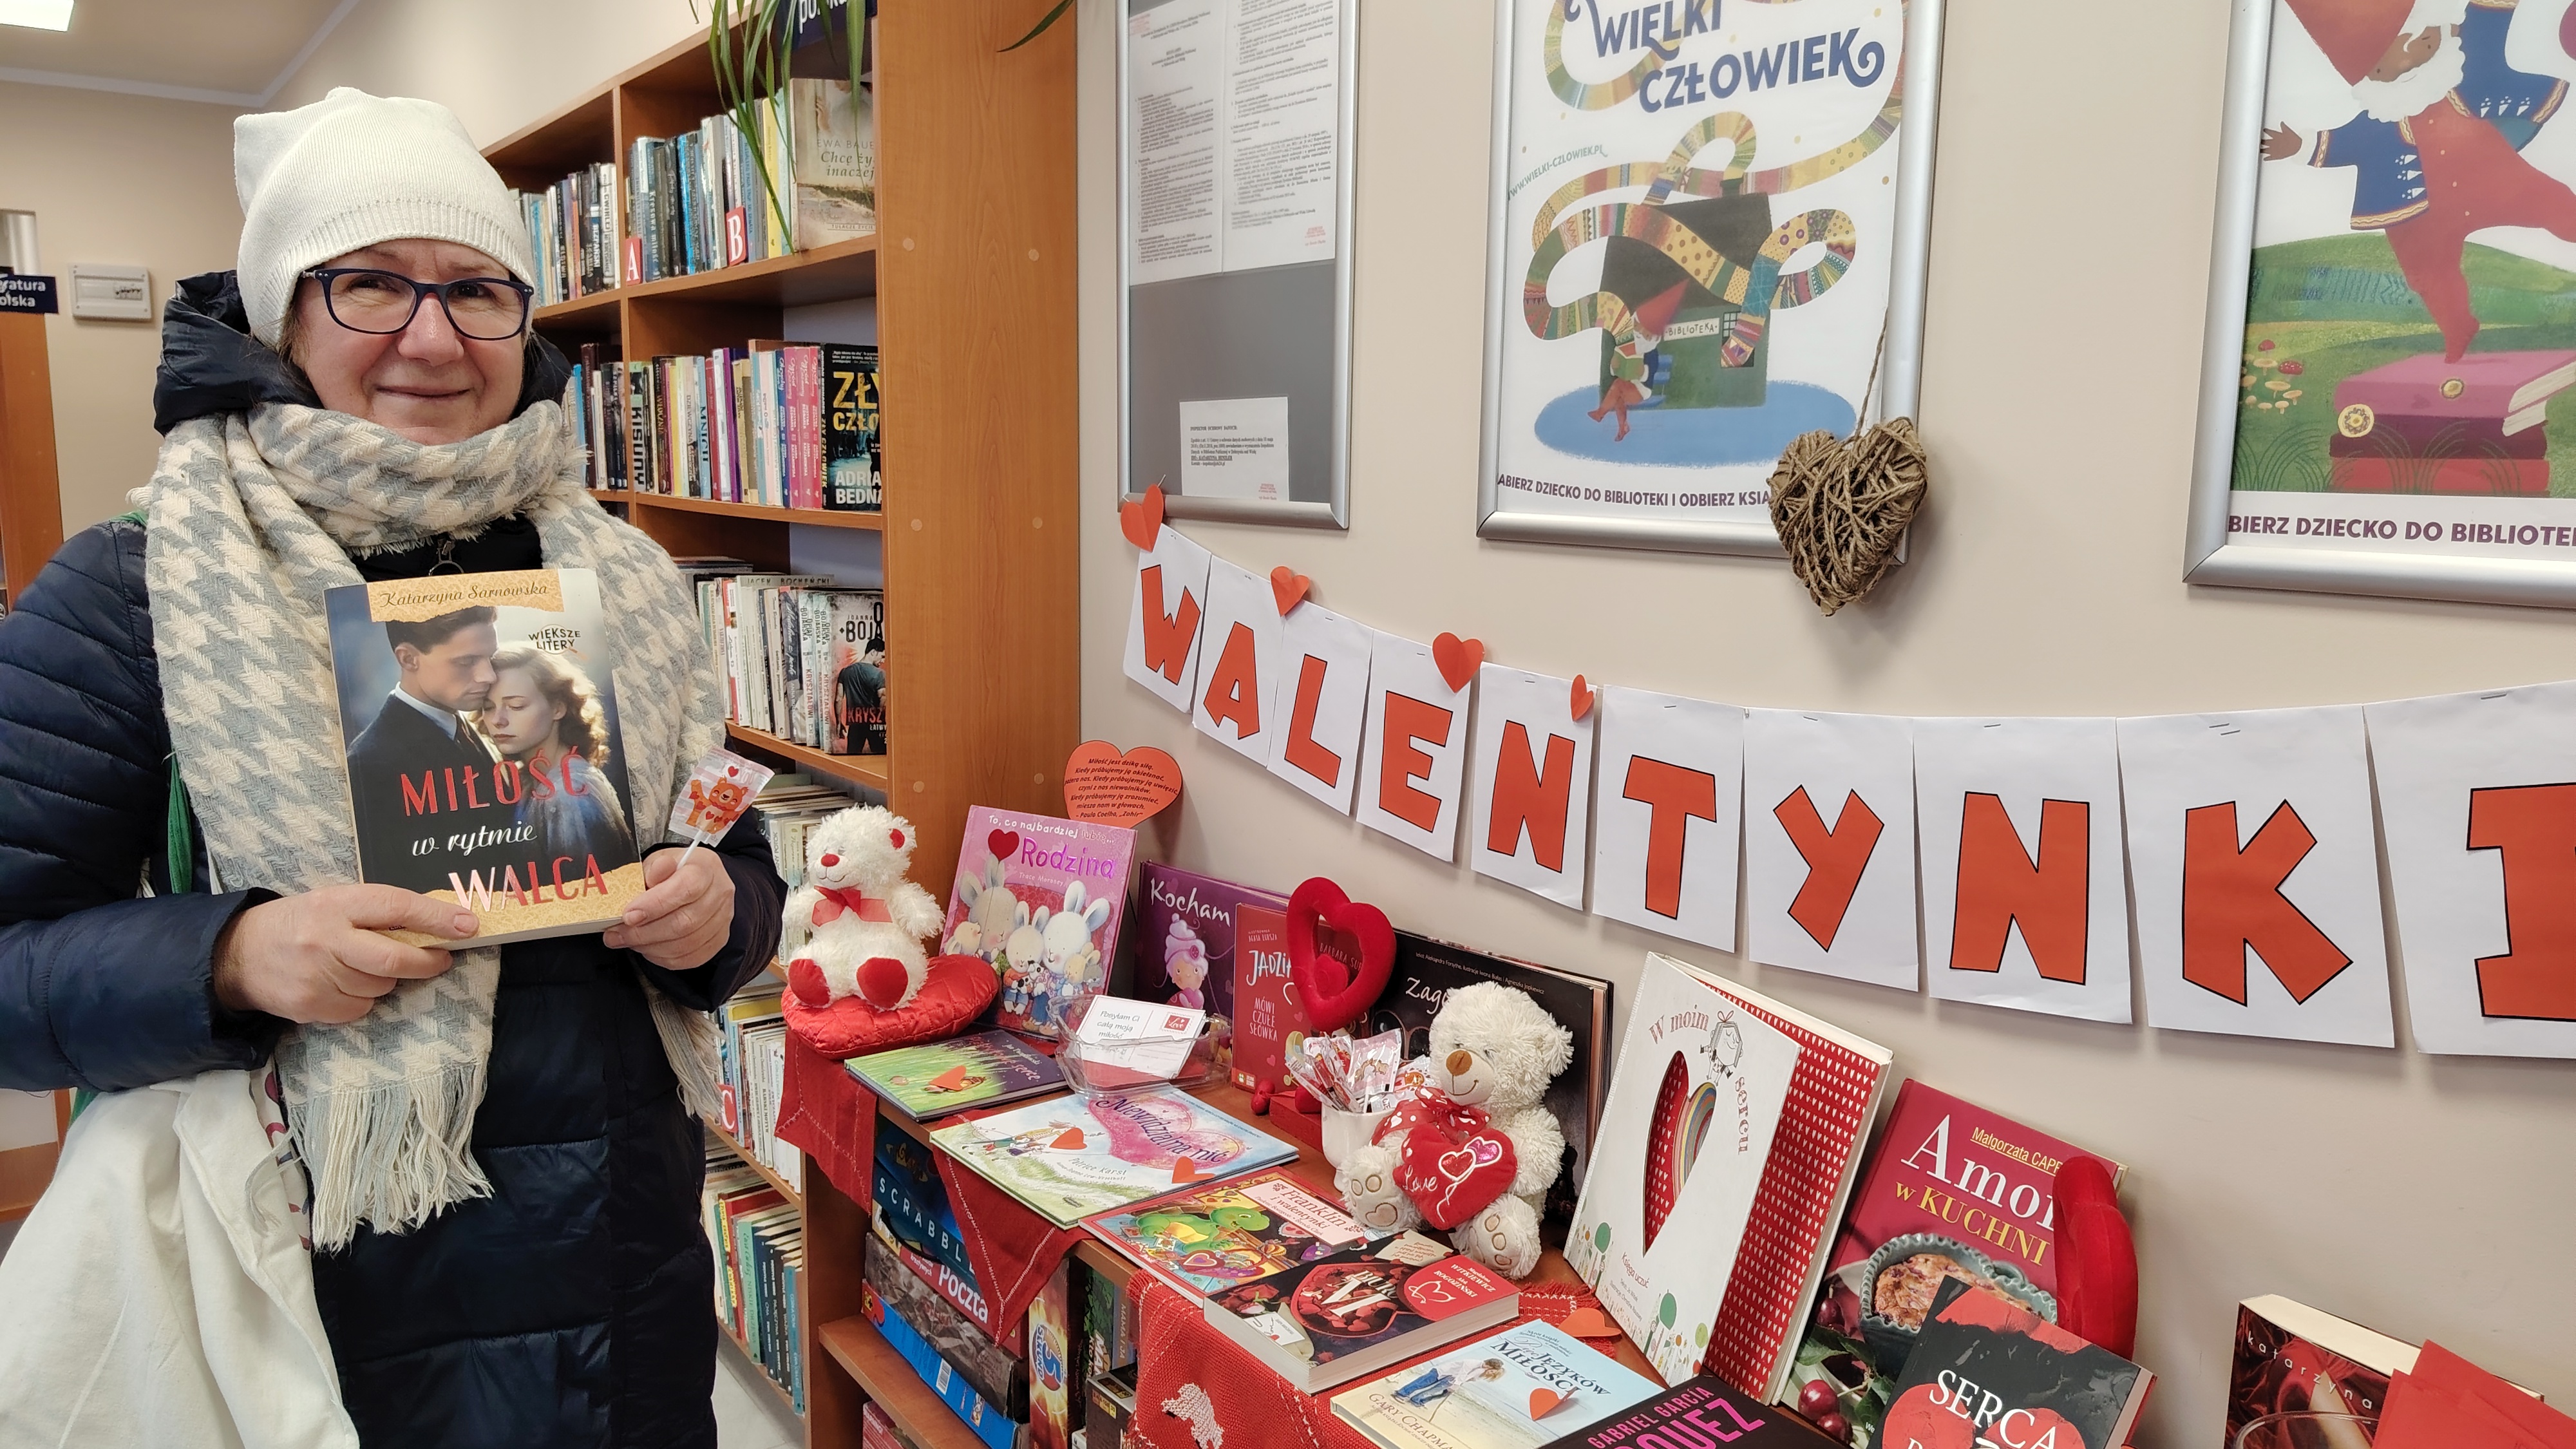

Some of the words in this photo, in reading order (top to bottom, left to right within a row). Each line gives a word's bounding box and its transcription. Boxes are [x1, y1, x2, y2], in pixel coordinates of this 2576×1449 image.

[1640, 27, 1885, 113] CZŁOWIEK
[817, 138, 841, 148] EWA
[821, 151, 852, 165] Chcę
[826, 165, 875, 179] inaczej
[728, 215, 743, 261] B
[626, 242, 640, 282] A
[1668, 322, 1714, 336] BIBLIOTEKA
[631, 407, 644, 485] KISUNY
[699, 406, 709, 462] MNICH
[835, 471, 882, 486] ADRIA
[1535, 480, 1581, 500] DZIECKO
[1584, 488, 1602, 502] DO
[1604, 490, 1669, 507] BIBLIOTEKI
[1672, 493, 1676, 507] I
[1679, 493, 1735, 507] ODBIERZ
[2296, 518, 2397, 540] DZIECKO
[2405, 521, 2443, 542] DO
[2450, 523, 2576, 547] BIBLIOTE
[380, 590, 464, 608] Katarzyna
[468, 582, 547, 600] Sarnowska
[528, 627, 581, 641] WIĘKSZE
[536, 639, 575, 651] LITERY
[401, 746, 589, 816] MIŁOŚĆ
[1110, 776, 1144, 786] próbujemy
[412, 837, 440, 857] w
[448, 820, 537, 857] rytmie
[989, 815, 1001, 828] To,
[1005, 819, 1017, 827] co
[1020, 820, 1079, 838] najbardziej
[1021, 837, 1117, 879] Rodzina
[448, 854, 609, 912] WALCA
[1150, 877, 1231, 927] Kocham
[1320, 943, 1347, 964] BARBARA
[1100, 1010, 1131, 1021] Posyłam
[1254, 996, 1275, 1011] MÓWI
[1097, 1021, 1113, 1030] całą
[1115, 1023, 1133, 1032] moją
[1249, 1023, 1278, 1042] SŁÓWKA
[1253, 1010, 1275, 1028] CZUŁE
[1648, 1014, 1666, 1045] W
[1670, 1005, 1709, 1033] moim
[1098, 1031, 1124, 1039] miłość
[721, 1089, 735, 1130] C
[1733, 1076, 1750, 1155] sercu
[1095, 1097, 1192, 1155] Niewidzialna
[1191, 1148, 1231, 1163] nić
[1970, 1127, 2030, 1162] Małgorzata
[1069, 1158, 1097, 1171] Patrice
[1099, 1167, 1127, 1175] Karst
[1403, 1165, 1437, 1193] Love
[1276, 1199, 1331, 1229] walentynki
[1280, 1189, 1347, 1227] Franklin
[1895, 1181, 1917, 1202] w
[1916, 1184, 2051, 1266] KUCHNI
[1434, 1270, 1479, 1298] ROGOZIŃSKI
[1450, 1264, 1496, 1293] WITKIEWICZ
[1468, 1267, 1491, 1283] Magdalena
[1622, 1252, 1636, 1277] Księga
[1634, 1273, 1649, 1288] uczuć
[1036, 1324, 1046, 1380] SEKUND
[1043, 1340, 1063, 1386] 5
[1534, 1352, 1611, 1395] JĘZYKÓW
[2247, 1331, 2372, 1410] katarzyna
[1368, 1393, 1403, 1416] GARY
[1587, 1414, 1660, 1449] GABRIEL
[1654, 1386, 1715, 1417] GARCÍA
[1929, 1369, 2057, 1449] SERCA
